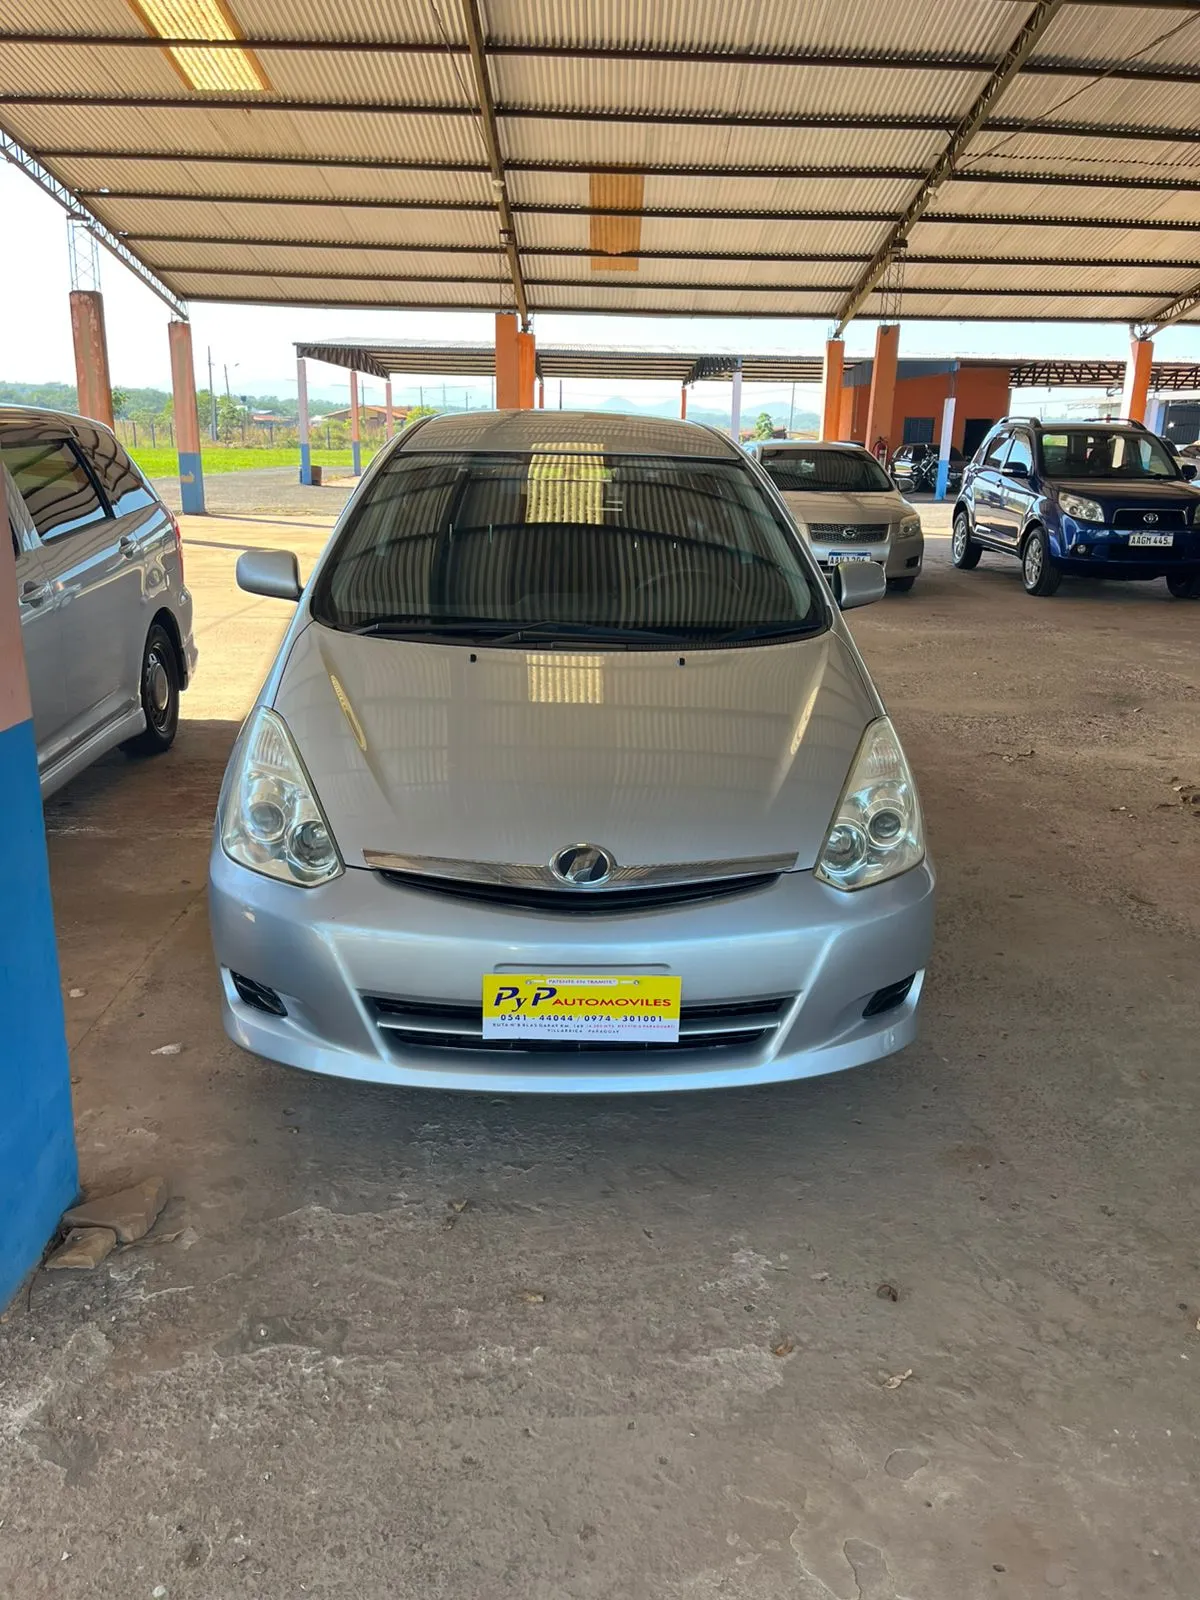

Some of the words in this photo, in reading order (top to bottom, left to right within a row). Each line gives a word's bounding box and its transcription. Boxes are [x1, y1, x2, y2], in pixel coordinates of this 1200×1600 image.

[1130, 536, 1152, 545] AAGM
[1153, 536, 1169, 545] 445
[552, 998, 672, 1007] AUTOMOVILES
